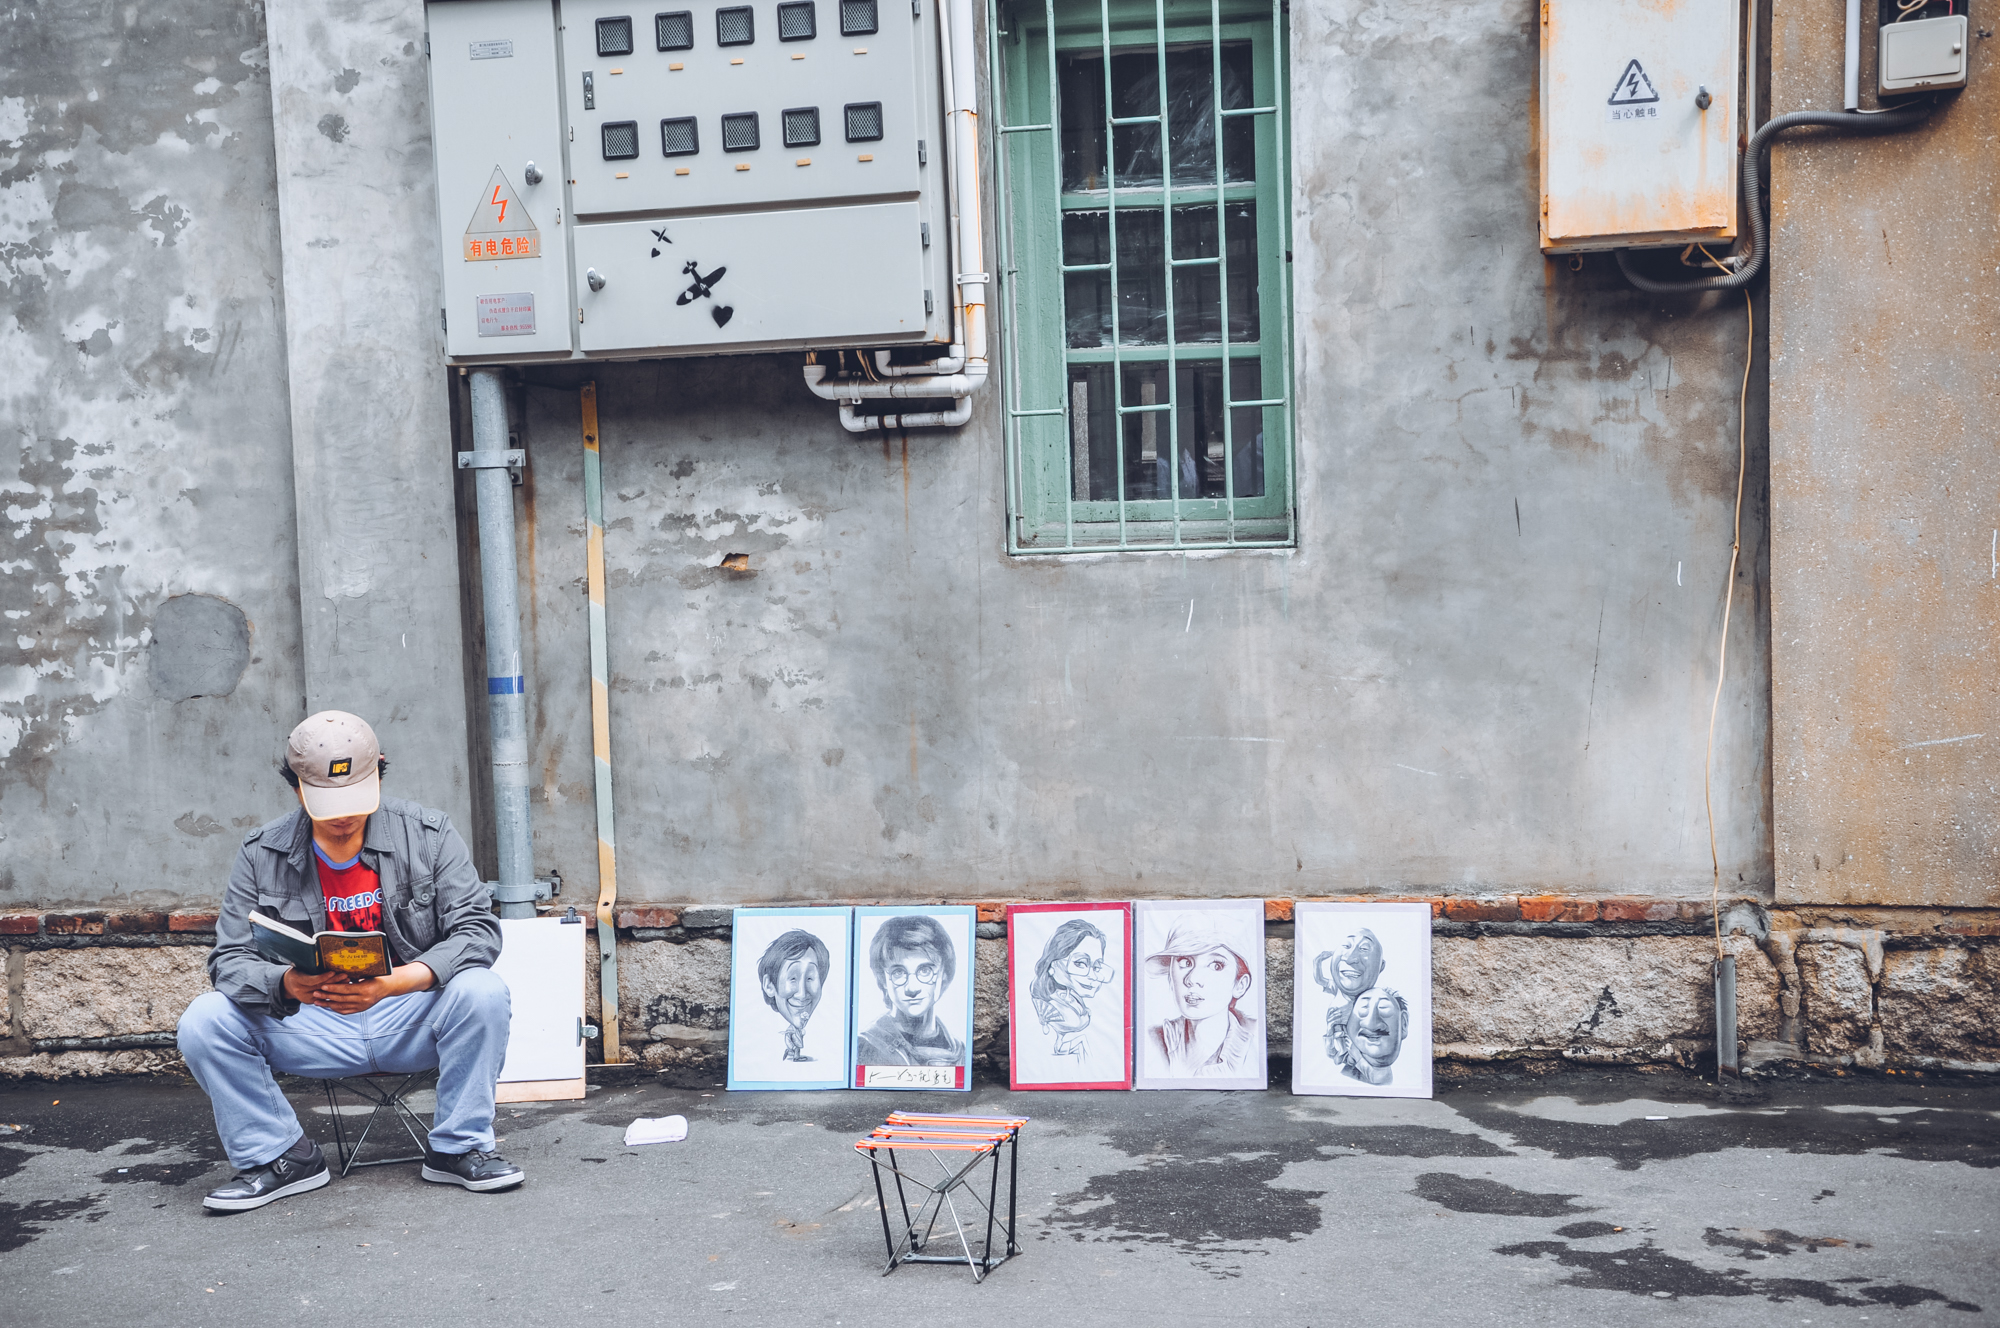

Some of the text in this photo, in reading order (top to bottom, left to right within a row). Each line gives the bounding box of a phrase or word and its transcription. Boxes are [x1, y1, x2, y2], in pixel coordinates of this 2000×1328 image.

[1612, 107, 1657, 119] 当心触电
[470, 236, 536, 257] 有电危险!
